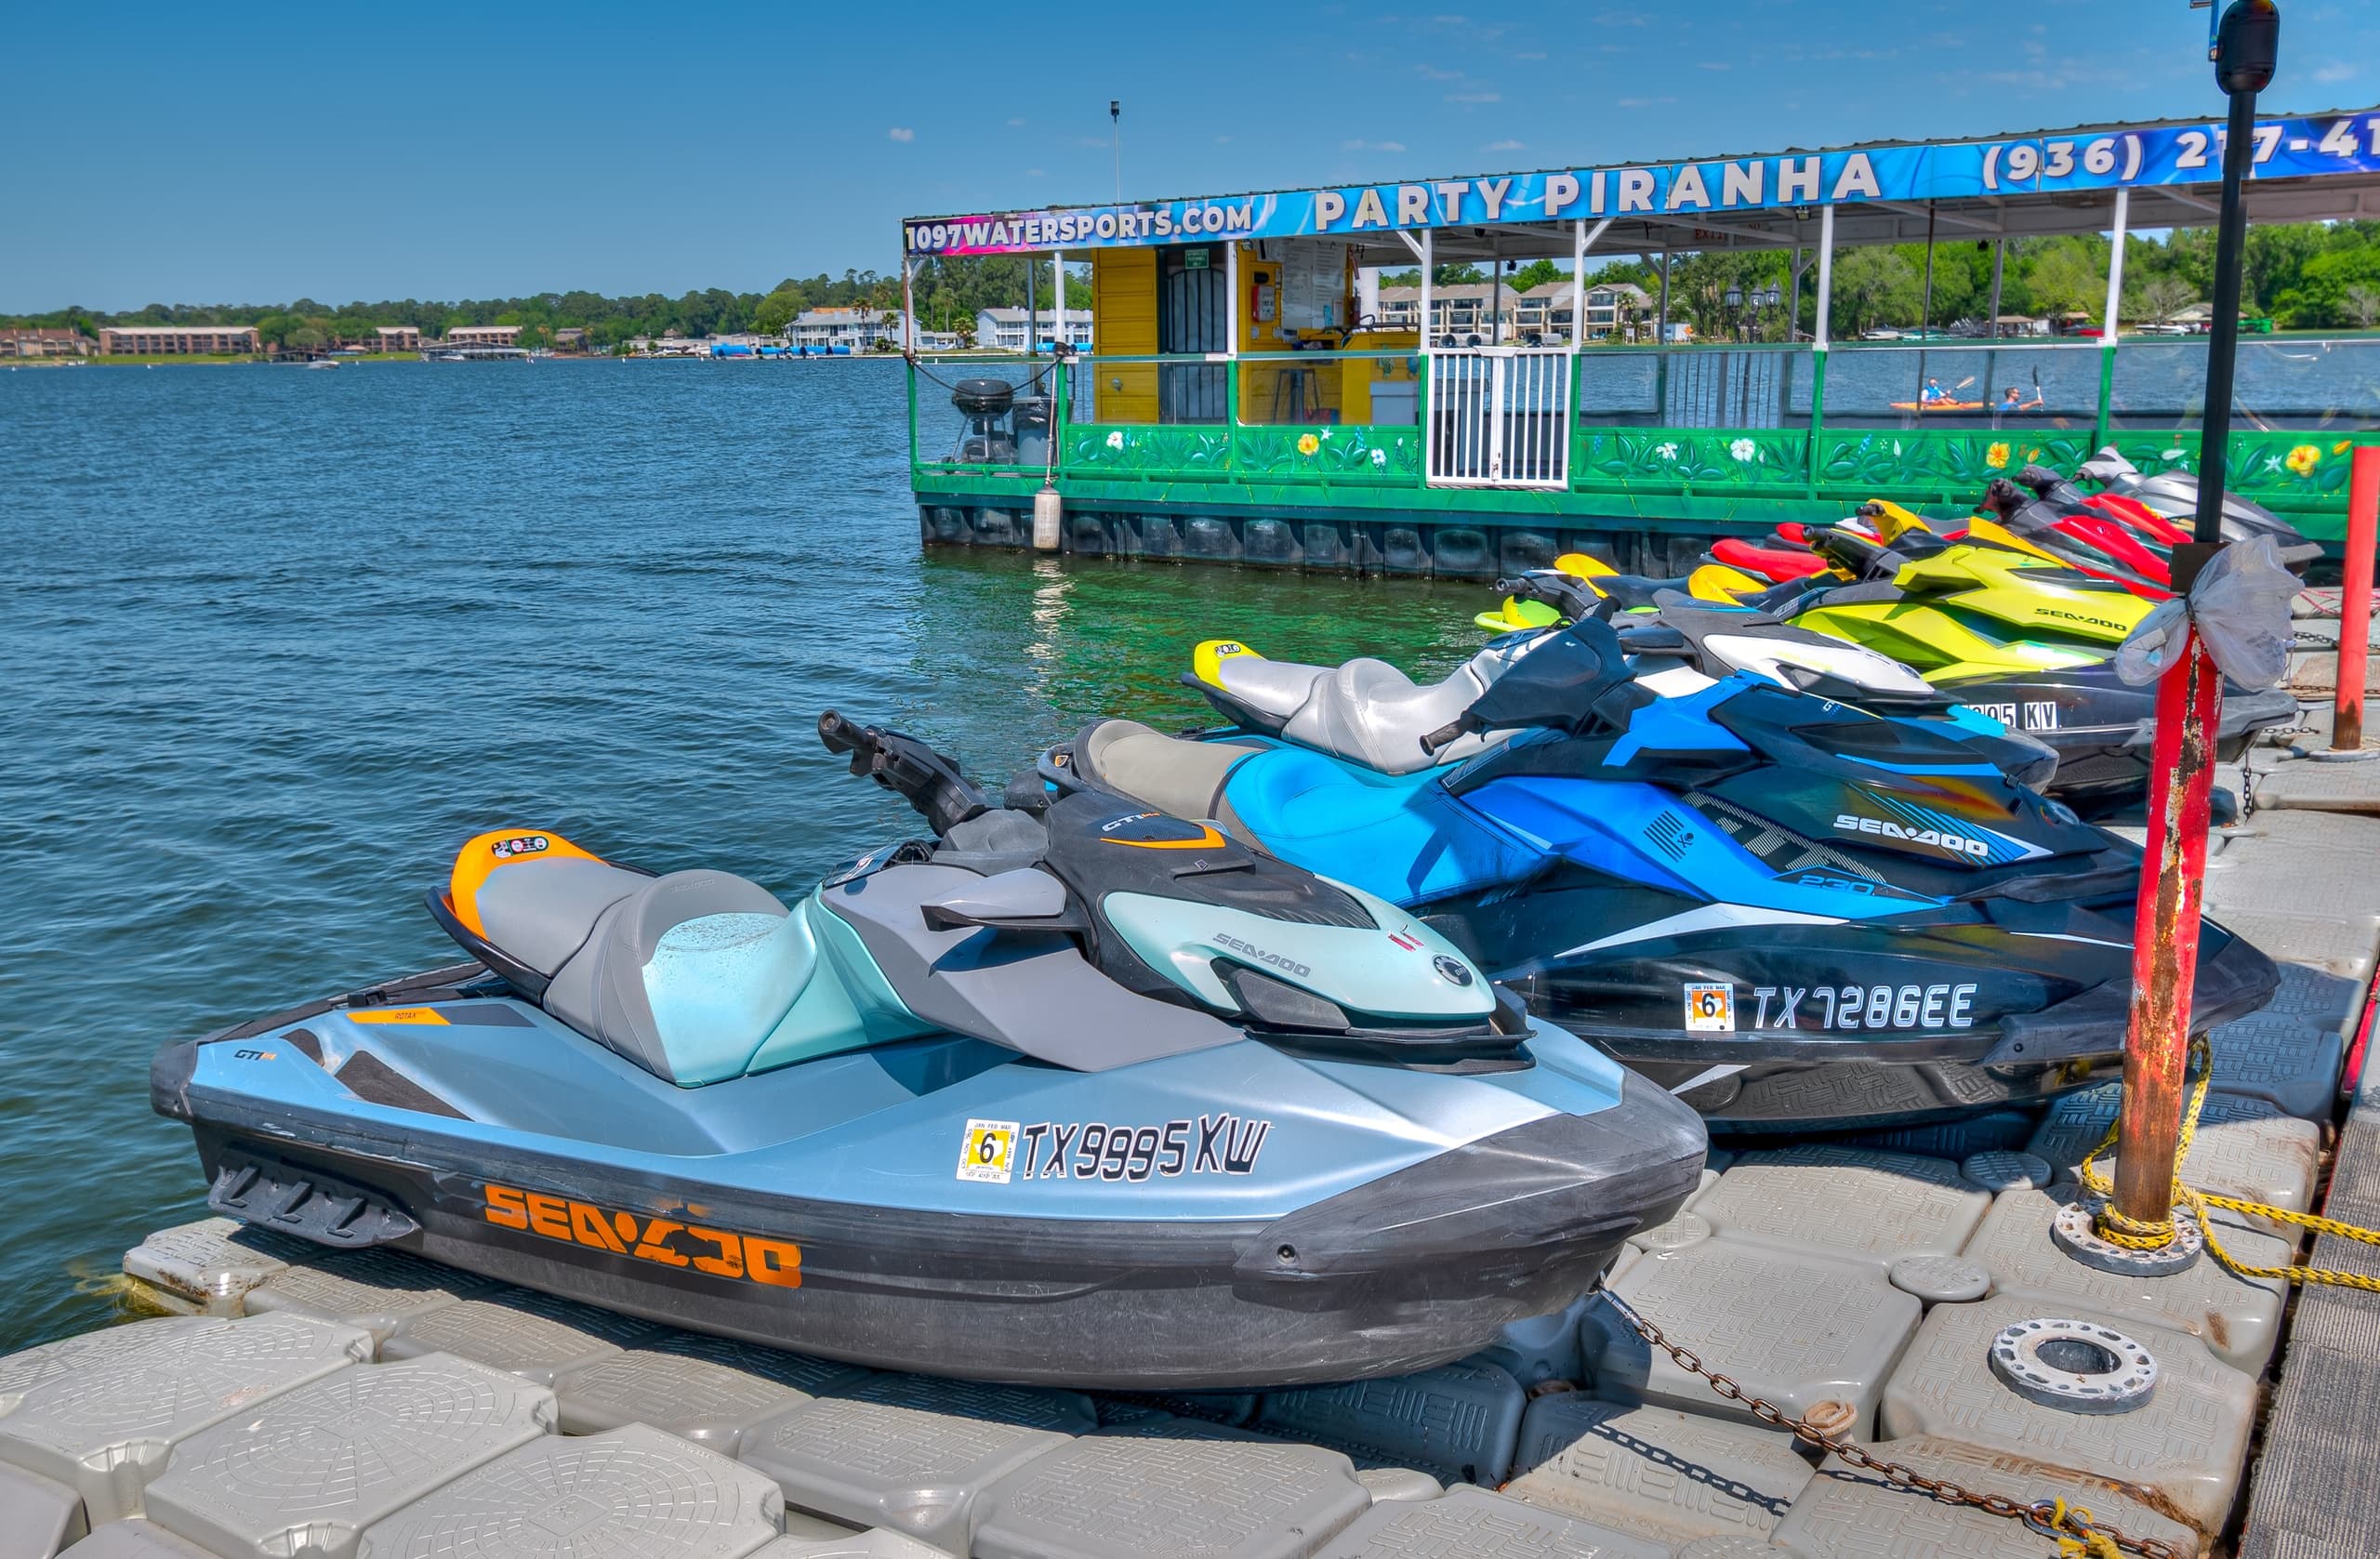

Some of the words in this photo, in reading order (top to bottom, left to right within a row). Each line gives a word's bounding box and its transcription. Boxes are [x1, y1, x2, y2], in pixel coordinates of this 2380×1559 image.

[1983, 135, 2141, 190] (936)
[1316, 178, 1512, 231] PARTY
[1545, 153, 1881, 216] PIRANHA
[906, 205, 1251, 250] 1097WATERSPORTS.COM
[2026, 703, 2055, 730] KV
[1798, 875, 1875, 896] 230
[1702, 993, 1715, 1018] 6
[979, 1132, 997, 1164] 6
